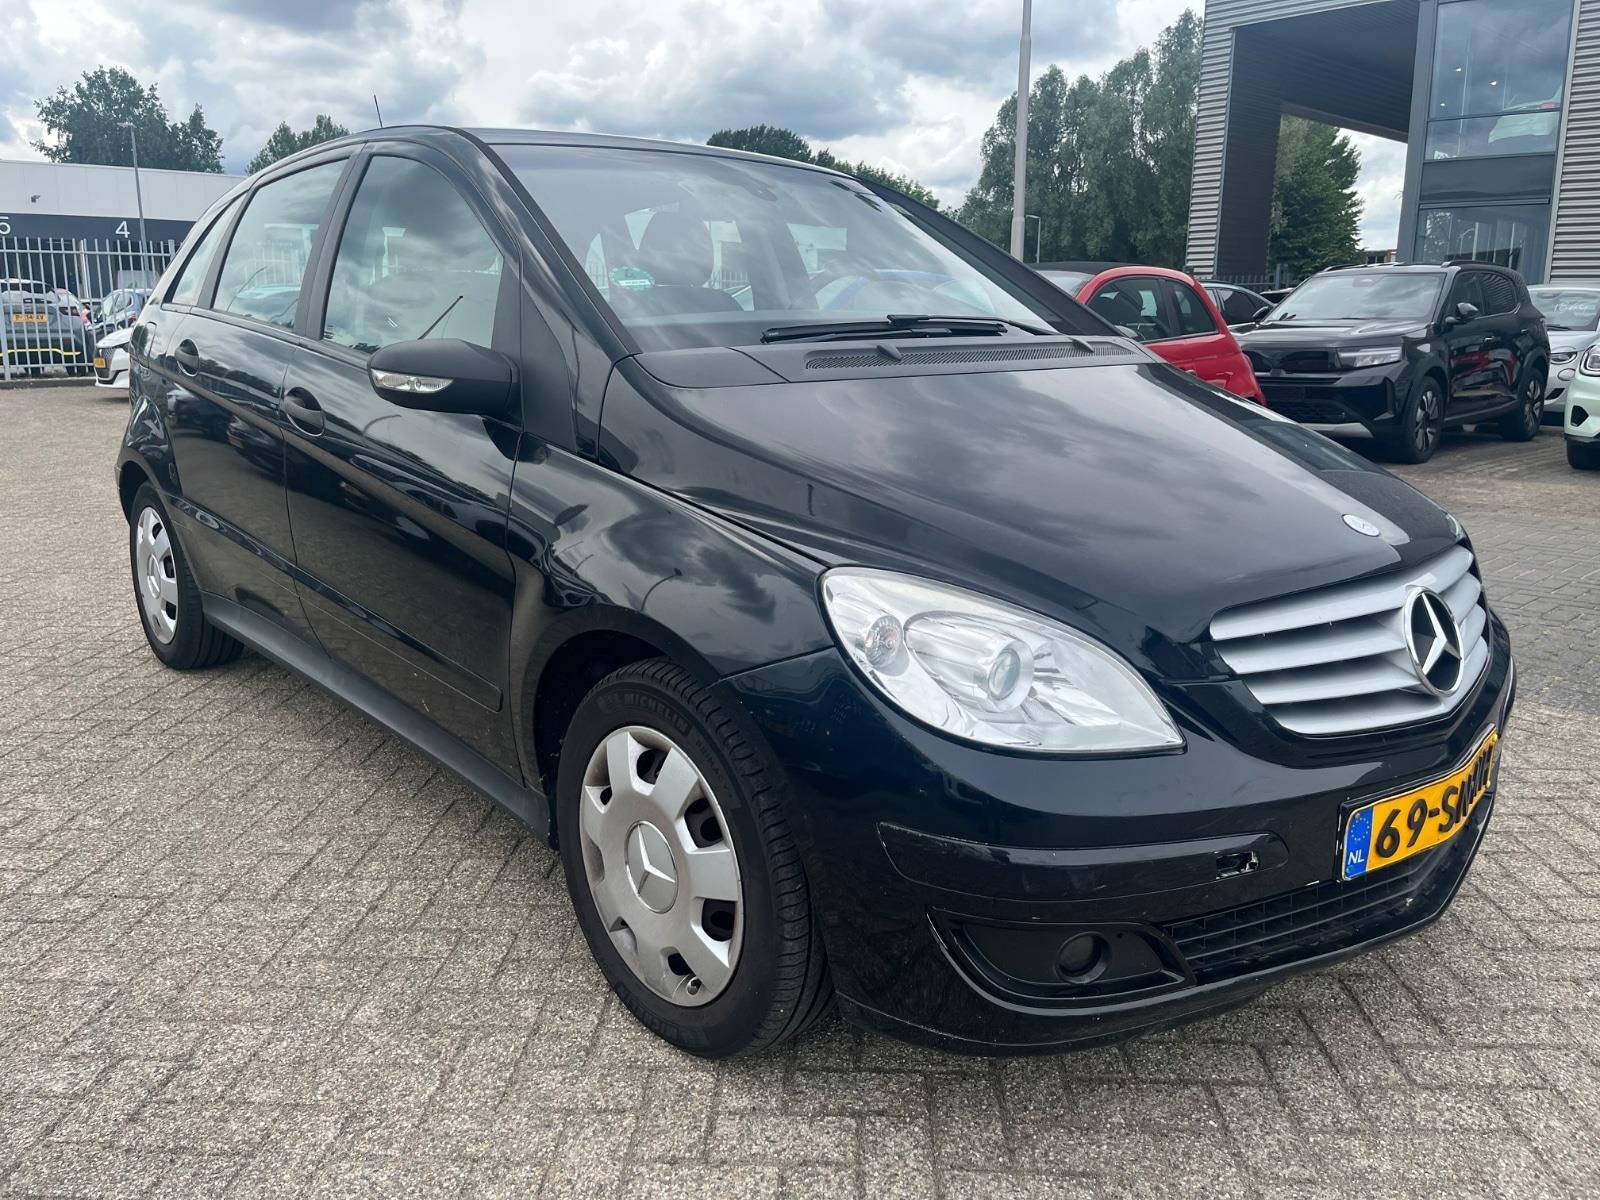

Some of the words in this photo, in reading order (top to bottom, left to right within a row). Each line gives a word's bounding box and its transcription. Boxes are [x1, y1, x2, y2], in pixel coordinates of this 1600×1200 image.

[115, 221, 130, 239] 4
[623, 693, 689, 734] MICHELIN
[1347, 849, 1365, 865] NL
